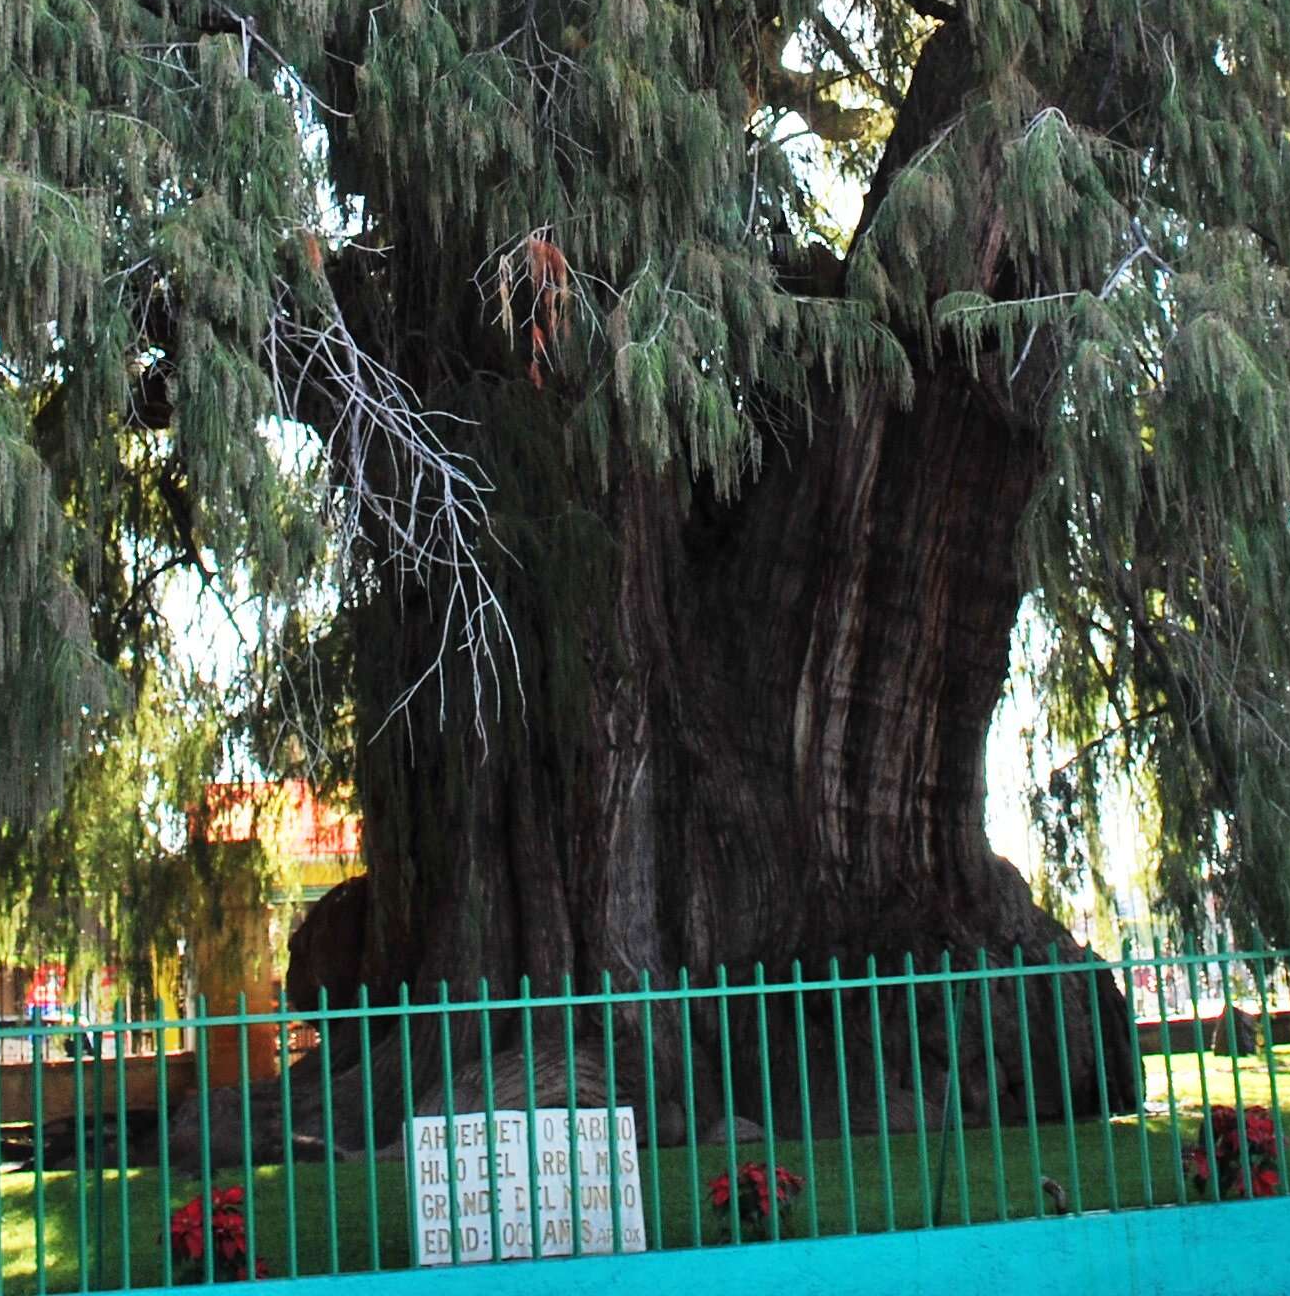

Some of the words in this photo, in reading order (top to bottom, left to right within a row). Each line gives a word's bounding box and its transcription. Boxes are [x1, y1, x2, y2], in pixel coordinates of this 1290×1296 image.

[420, 1158, 466, 1185] HIJO
[533, 1150, 589, 1176] RBL
[563, 1183, 636, 1211] MUNO
[543, 1218, 593, 1245] AÑS
[596, 1227, 641, 1245] APOX
